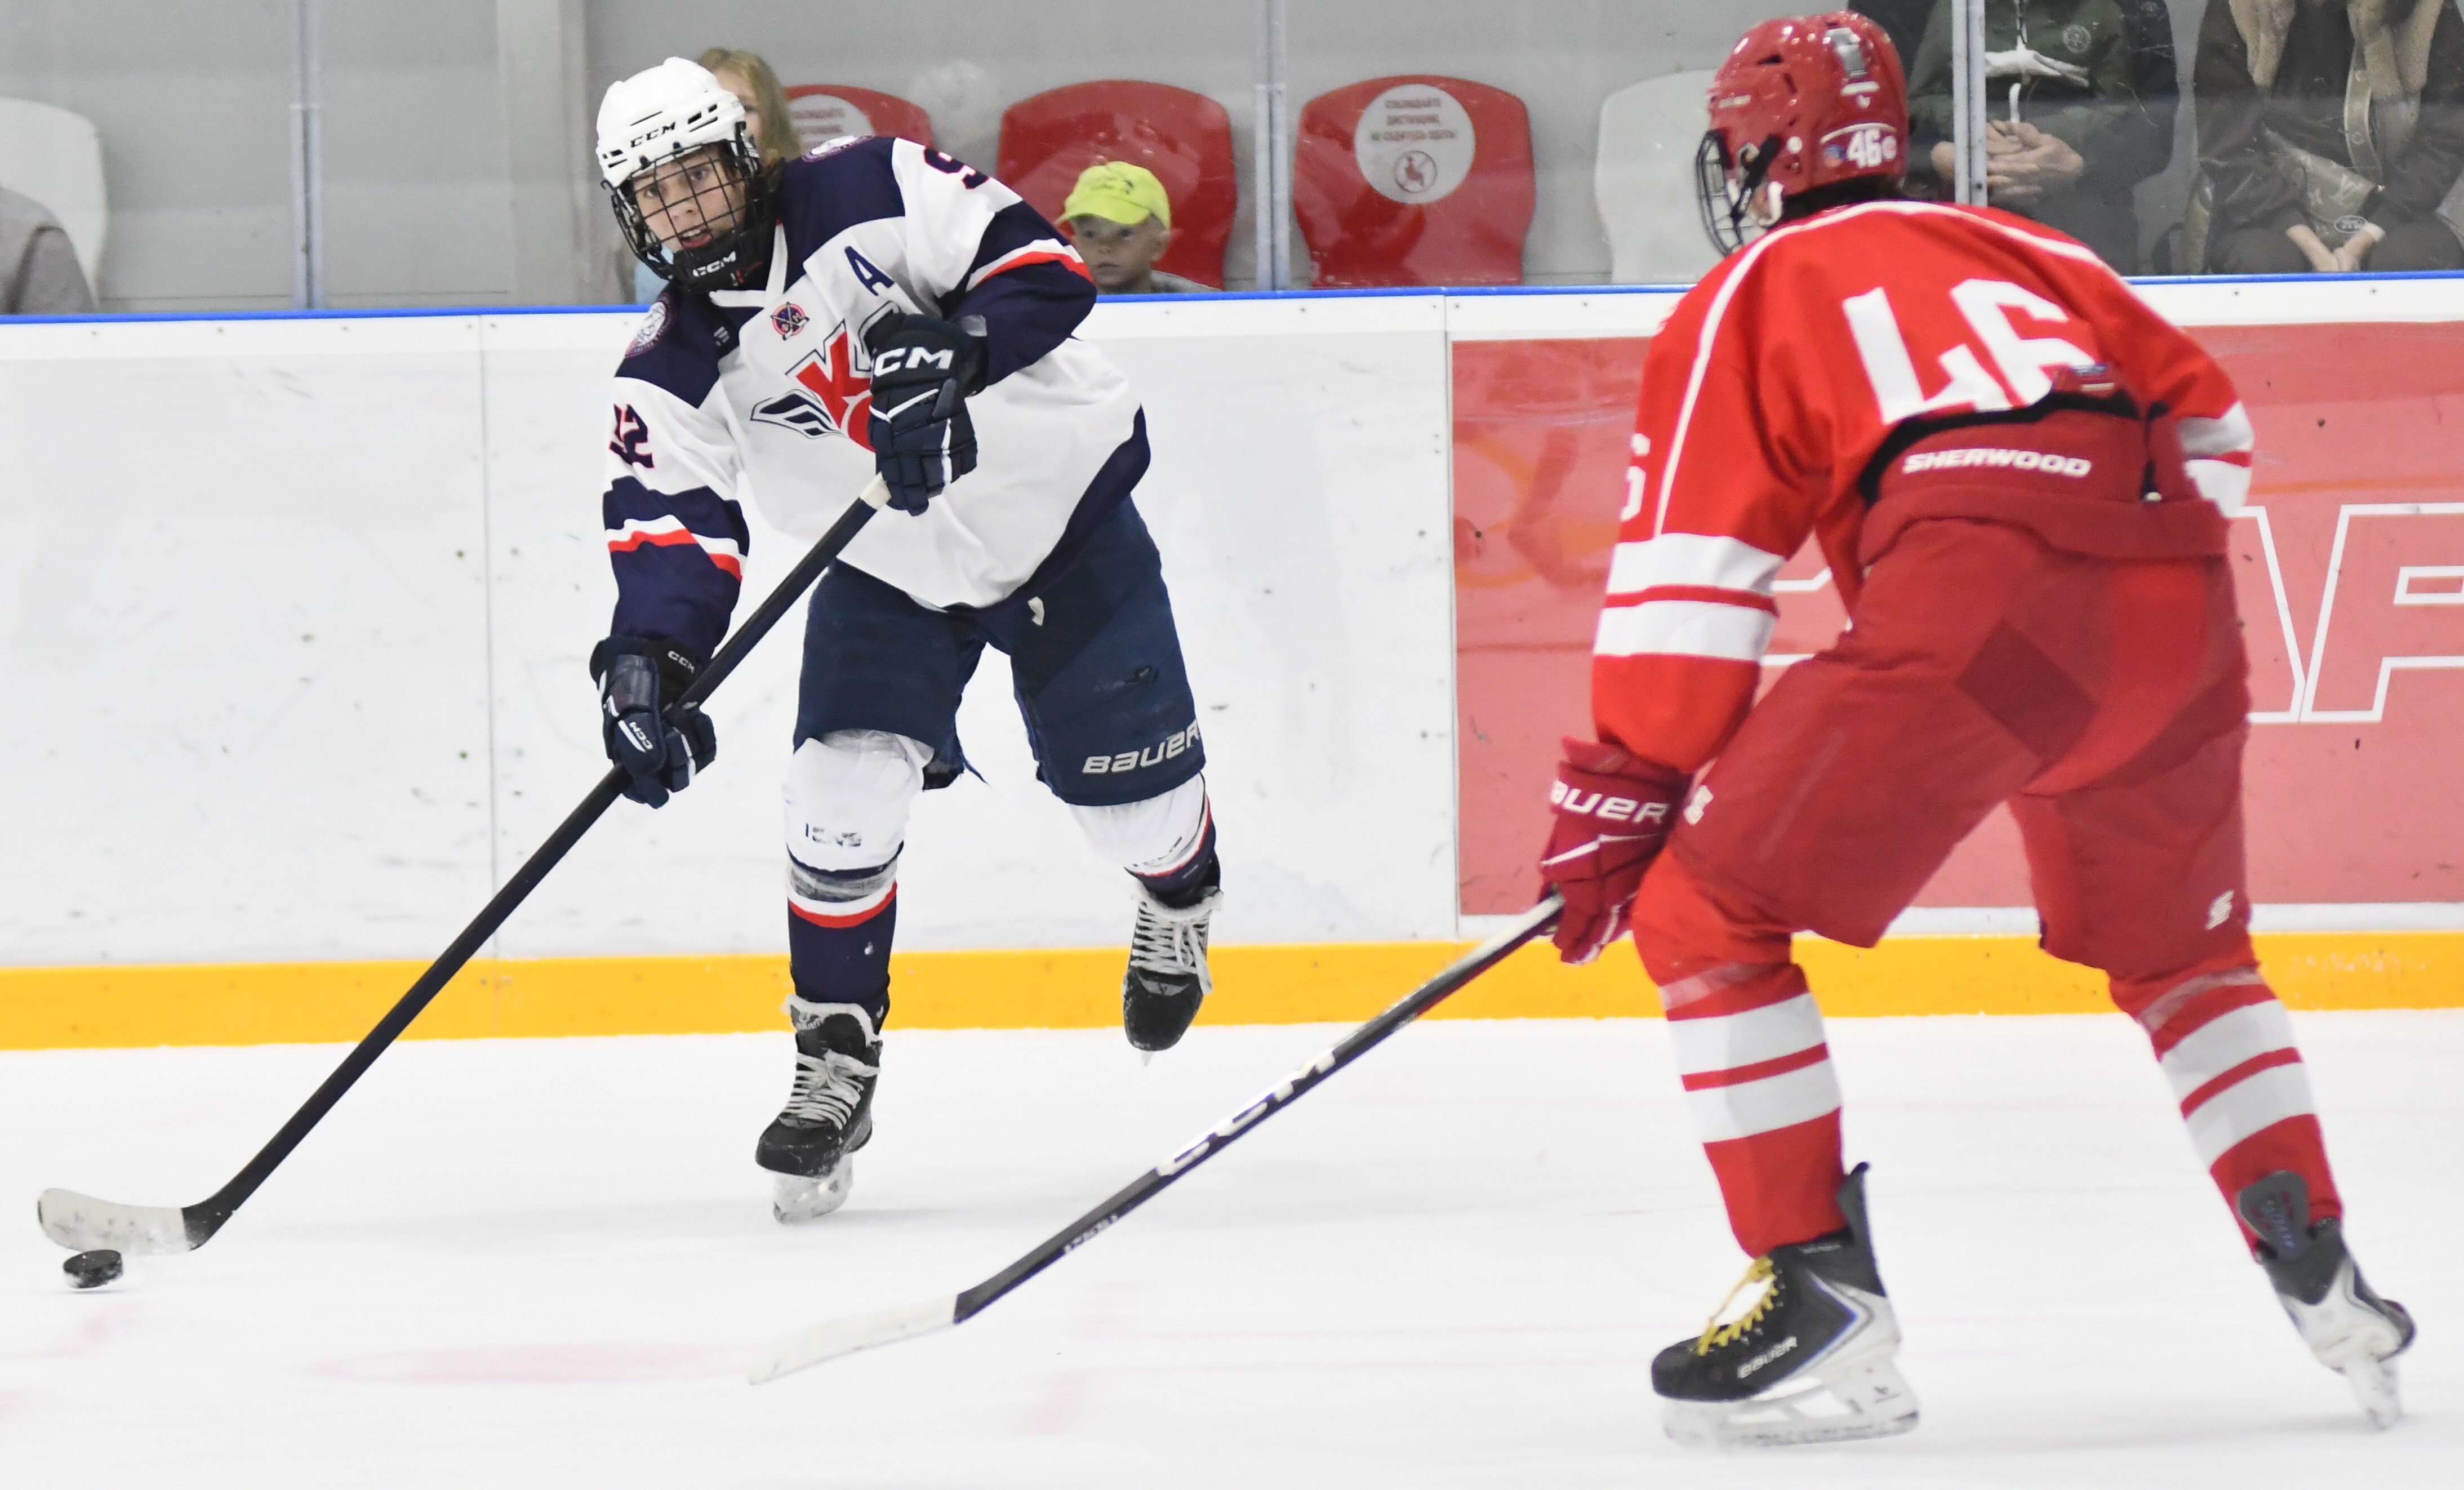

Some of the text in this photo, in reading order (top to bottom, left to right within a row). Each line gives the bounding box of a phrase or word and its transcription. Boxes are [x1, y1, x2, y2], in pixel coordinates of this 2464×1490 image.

[630, 121, 677, 148] CCM
[1847, 128, 1881, 168] 46
[692, 251, 737, 278] CCM
[844, 246, 895, 297] A
[873, 346, 955, 377] CM
[1902, 448, 2092, 477] SHERWOOD
[1549, 779, 1670, 824] AUER
[1155, 1047, 1336, 1177] CCM
[1737, 1335, 1798, 1379] BAUER
